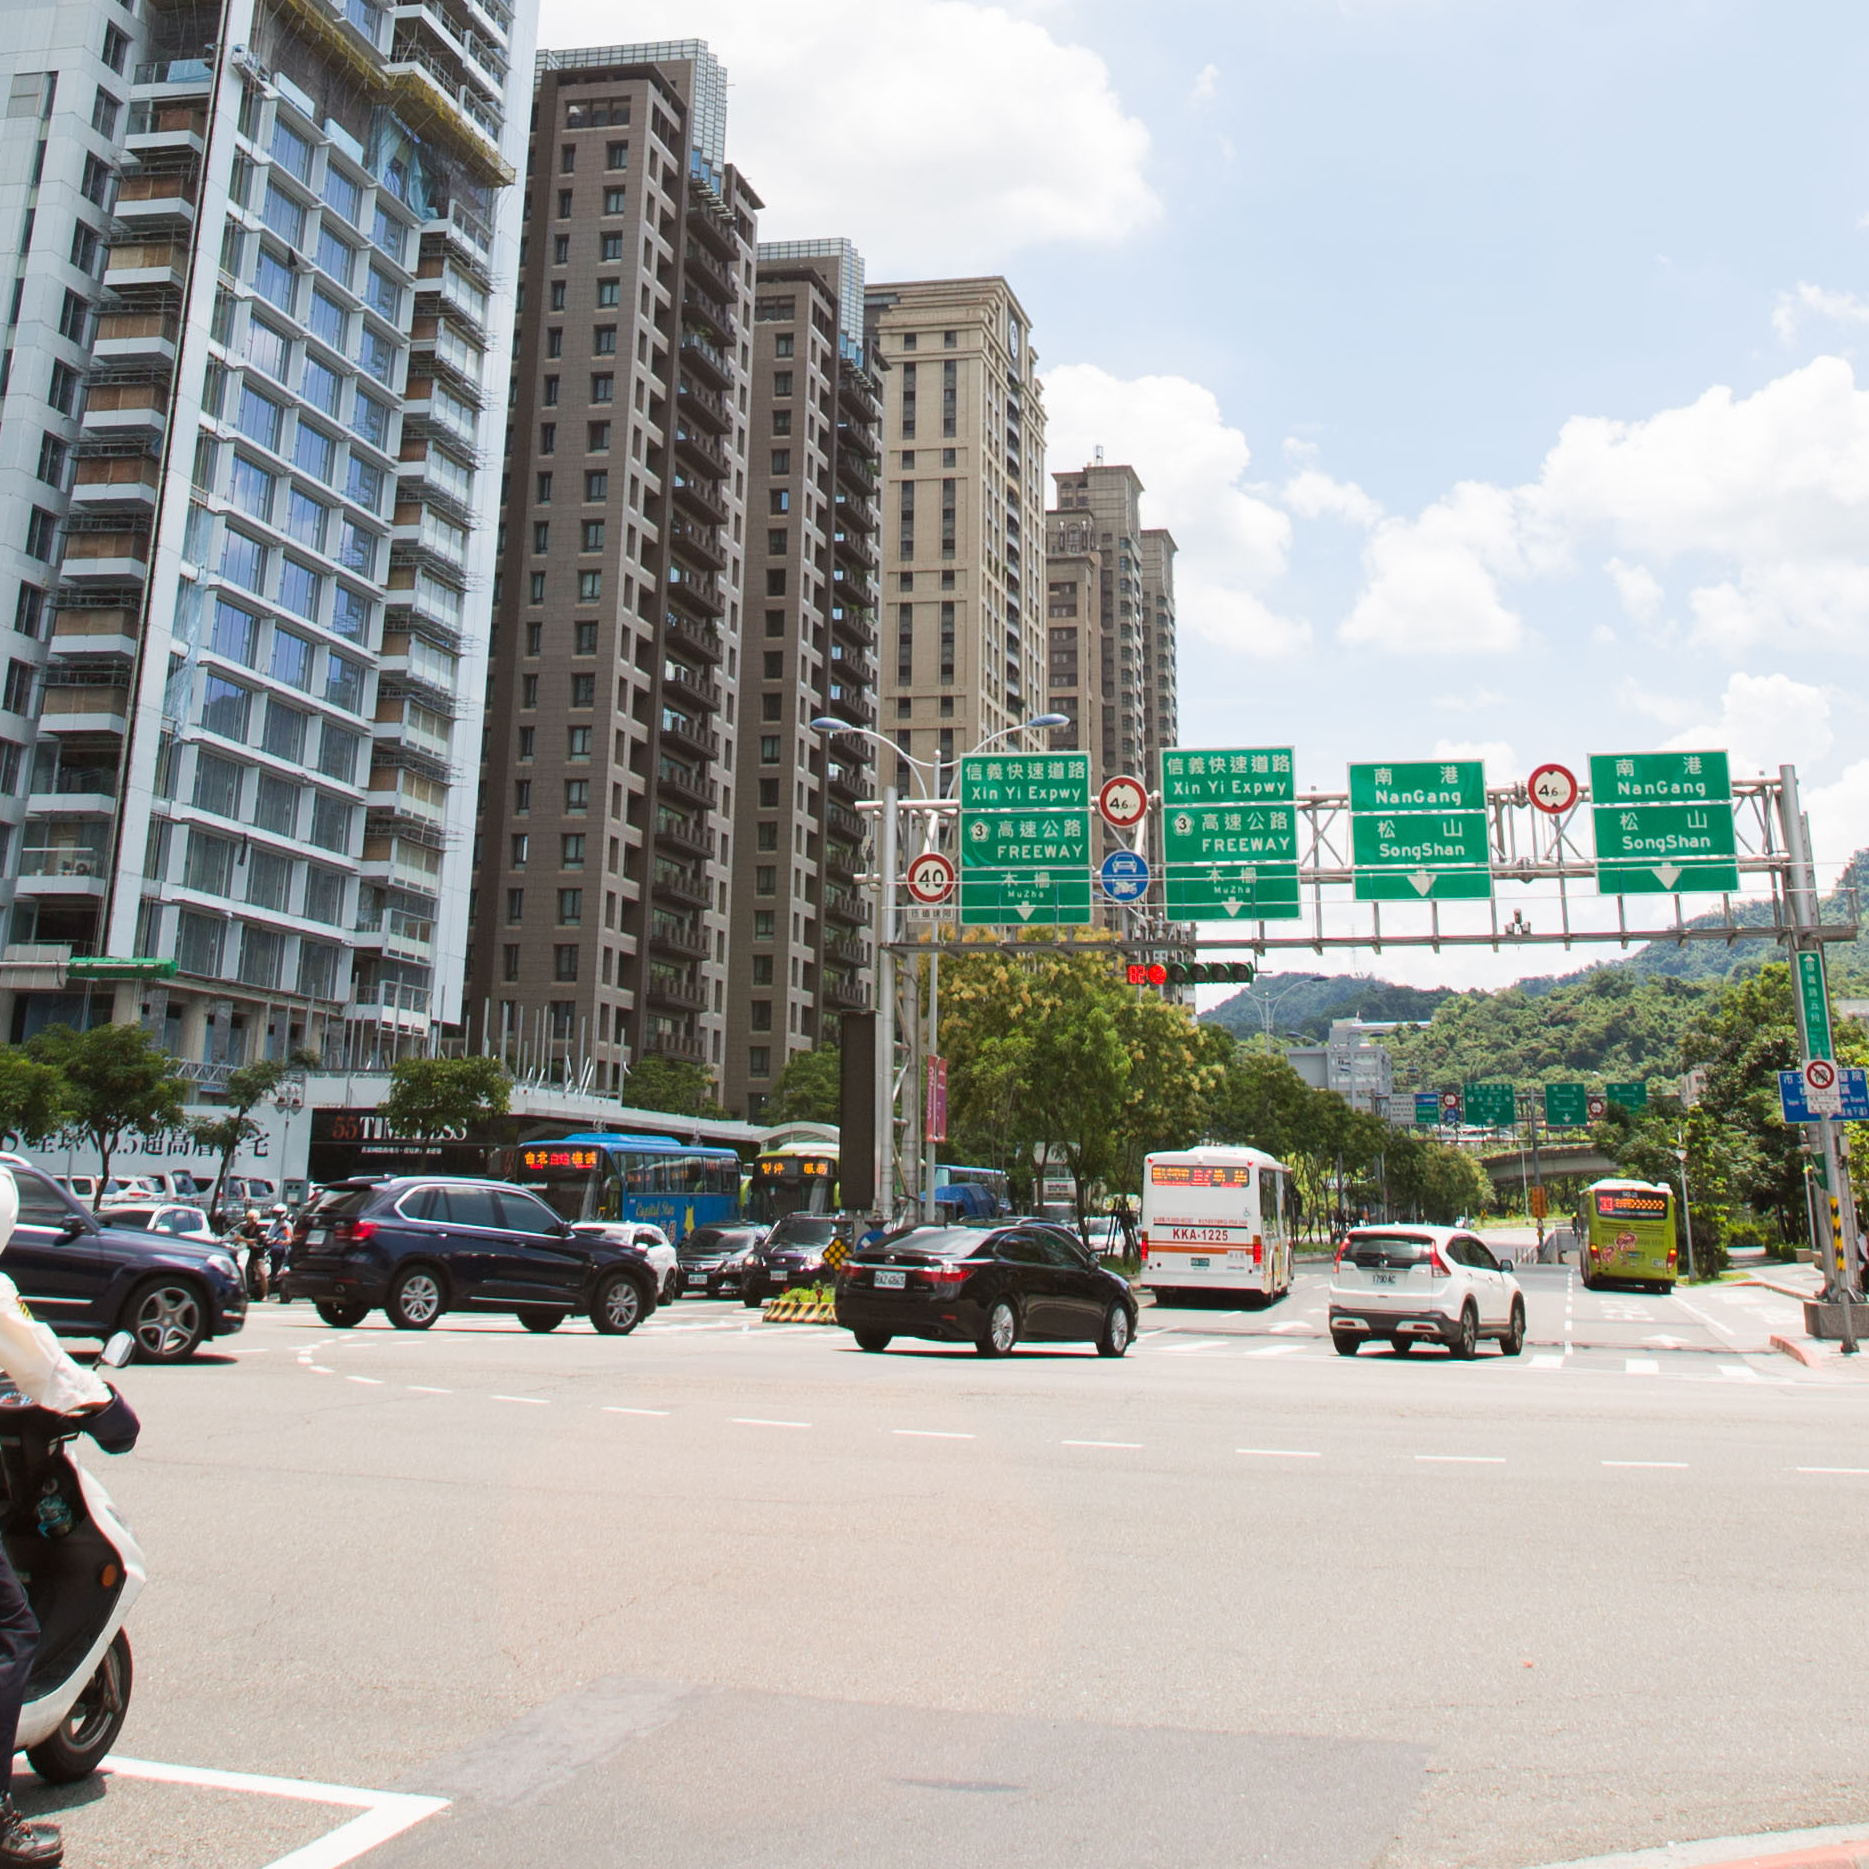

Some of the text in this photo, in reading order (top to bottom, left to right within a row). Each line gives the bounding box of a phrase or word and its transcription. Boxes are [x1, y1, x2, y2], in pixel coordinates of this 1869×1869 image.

[965, 761, 1085, 781] 信義快速道路
[1167, 754, 1291, 776] 信義快速道路
[1615, 755, 1702, 777] 南港
[1374, 765, 1458, 786] 南港
[971, 787, 1081, 802] Xin Yi Expwy
[1173, 780, 1286, 796] Xin Yi Expwy
[1617, 781, 1706, 797] NanGang
[1375, 790, 1461, 805] NanGang
[997, 819, 1082, 838] 高速公路
[1202, 811, 1288, 831] 高速公路
[1377, 818, 1463, 839] 松山
[1619, 809, 1707, 831] 松山
[997, 844, 1084, 859] FREEWAY
[1202, 837, 1290, 852] FREEWAY
[1379, 842, 1465, 860] SongShan
[1622, 835, 1711, 853] SongShan
[918, 869, 944, 888] 40
[1007, 890, 1044, 898] MuZha
[1214, 886, 1251, 894] MuZha
[333, 1116, 357, 1139] 55
[1172, 1228, 1228, 1241] KKA-1225
